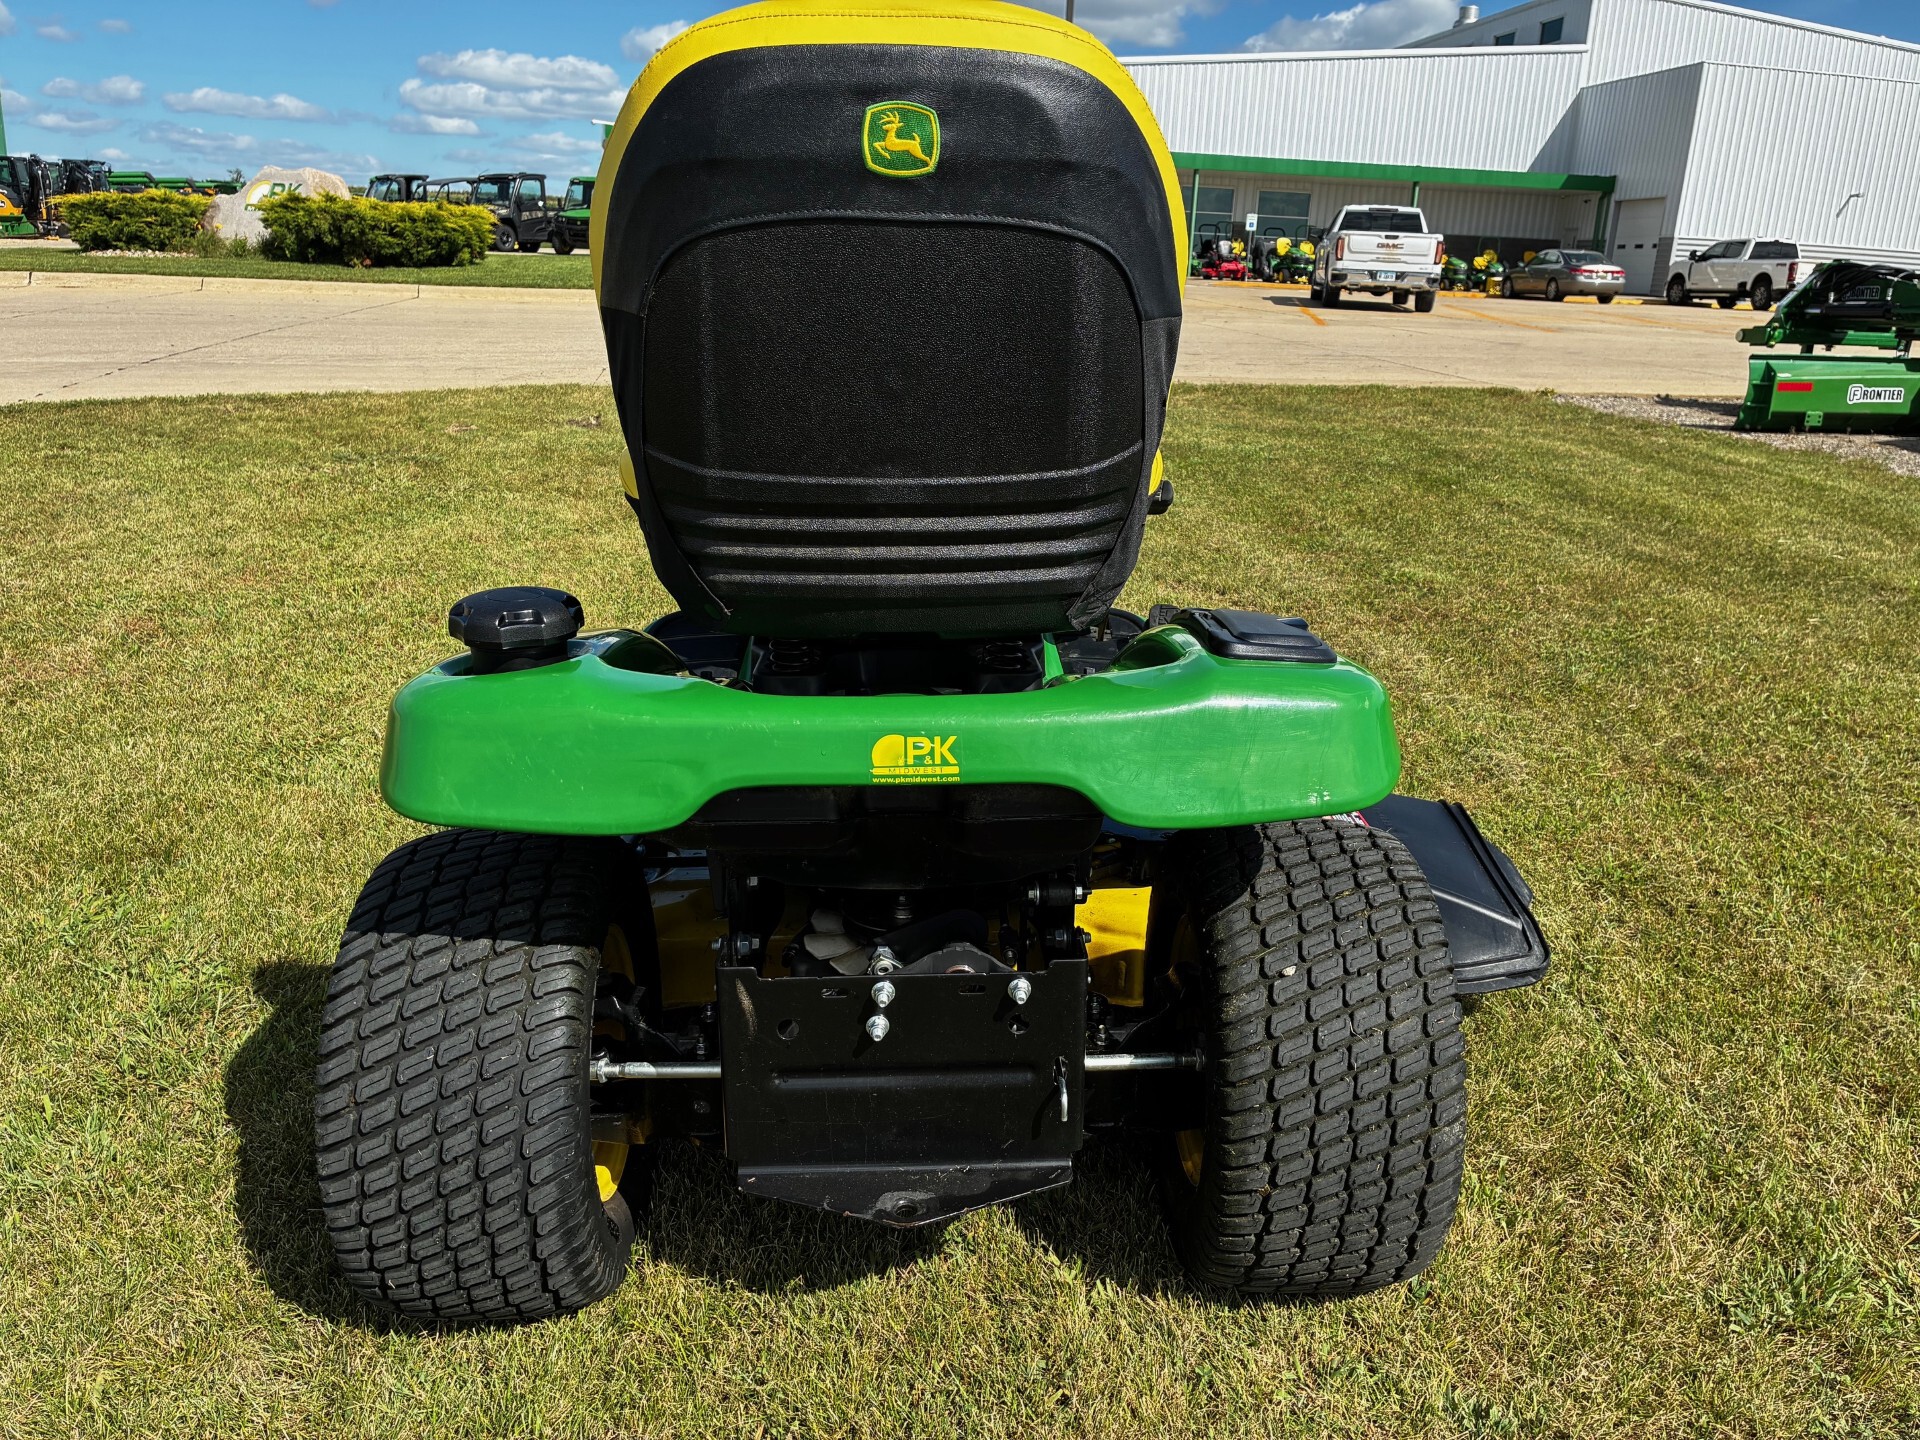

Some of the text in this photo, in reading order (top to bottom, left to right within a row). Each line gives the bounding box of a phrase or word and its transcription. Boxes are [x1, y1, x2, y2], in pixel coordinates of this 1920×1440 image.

[1848, 385, 1903, 402] FRONTIER
[906, 735, 958, 765] P&K
[872, 776, 960, 784] www.pkmidwest.com
